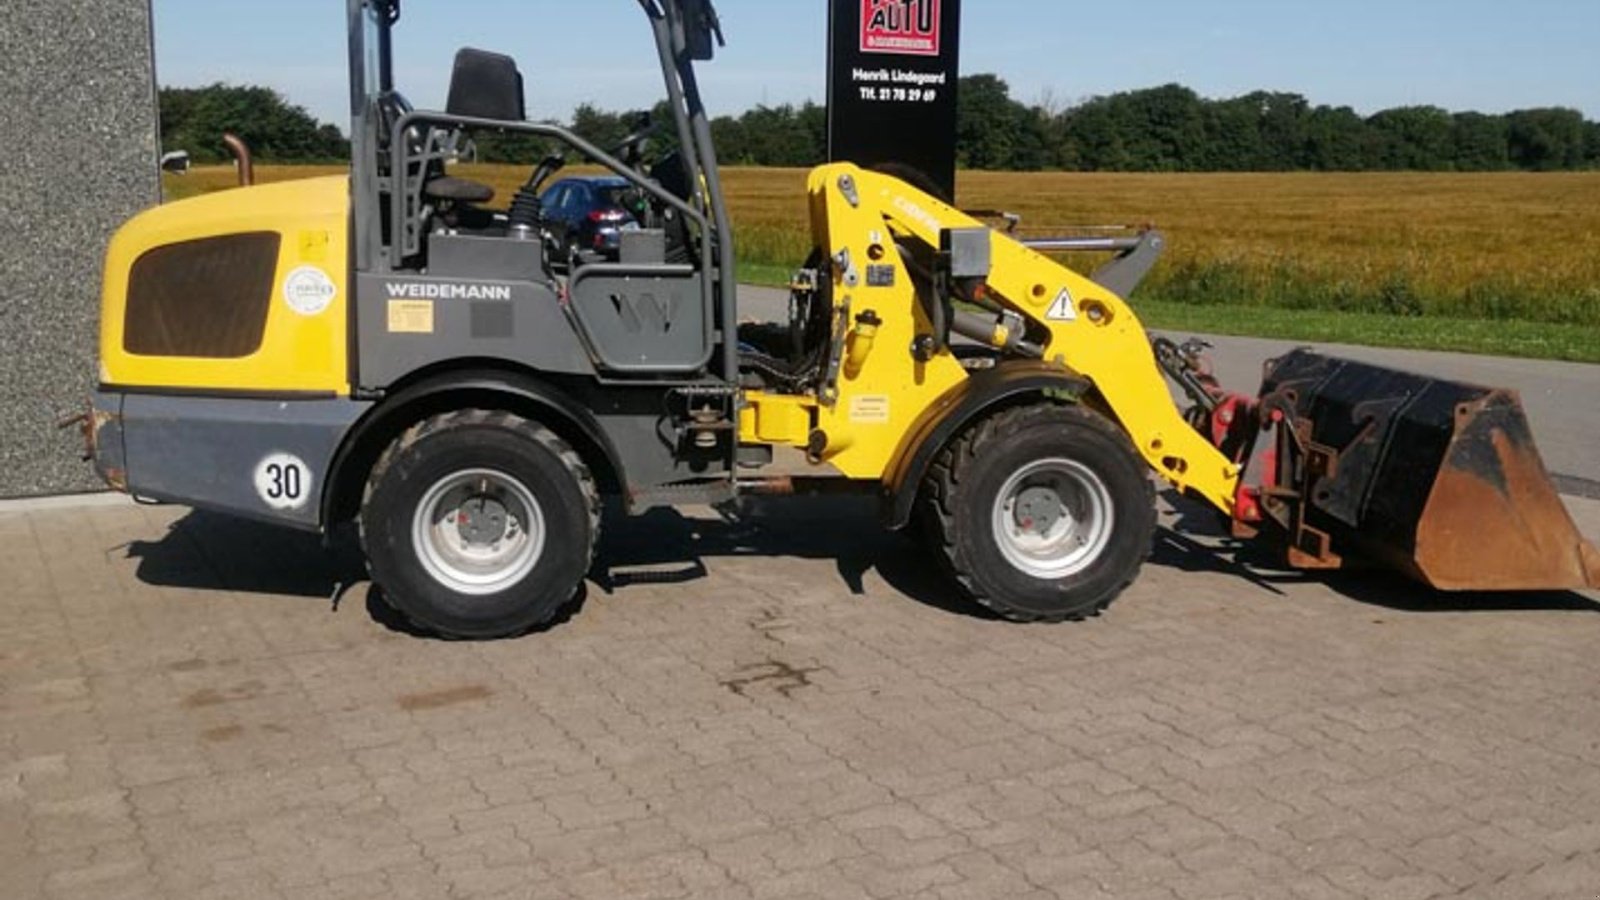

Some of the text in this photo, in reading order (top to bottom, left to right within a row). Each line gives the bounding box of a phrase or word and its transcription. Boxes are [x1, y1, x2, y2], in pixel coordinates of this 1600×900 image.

[852, 68, 946, 85] Henrik Lindegaard
[879, 88, 890, 101] 21
[908, 88, 921, 102] 29
[386, 283, 511, 299] WEIDEMANN
[267, 463, 300, 499] 30
